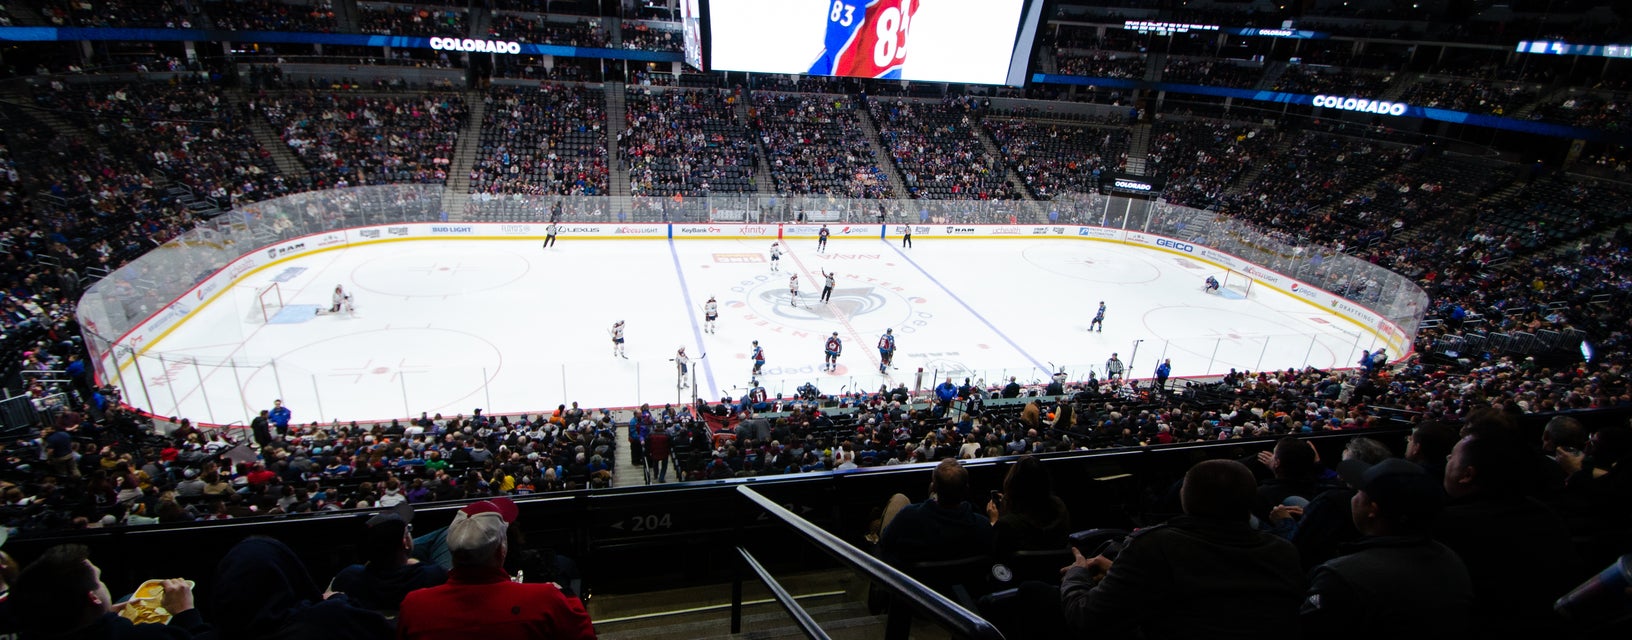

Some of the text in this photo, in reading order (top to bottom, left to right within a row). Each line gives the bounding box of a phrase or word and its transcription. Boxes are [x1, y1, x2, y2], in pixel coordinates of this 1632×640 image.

[830, 0, 856, 27] 83
[429, 36, 520, 54] COLORADO
[1312, 94, 1406, 116] COLORADO
[1115, 181, 1151, 190] COLORADO
[739, 226, 766, 235] xfinity
[279, 243, 305, 254] RAM
[1156, 238, 1193, 252] GEICO
[1263, 274, 1278, 283] LIGHT
[1339, 303, 1374, 323] DRAFTKINGS
[631, 512, 672, 531] 204
